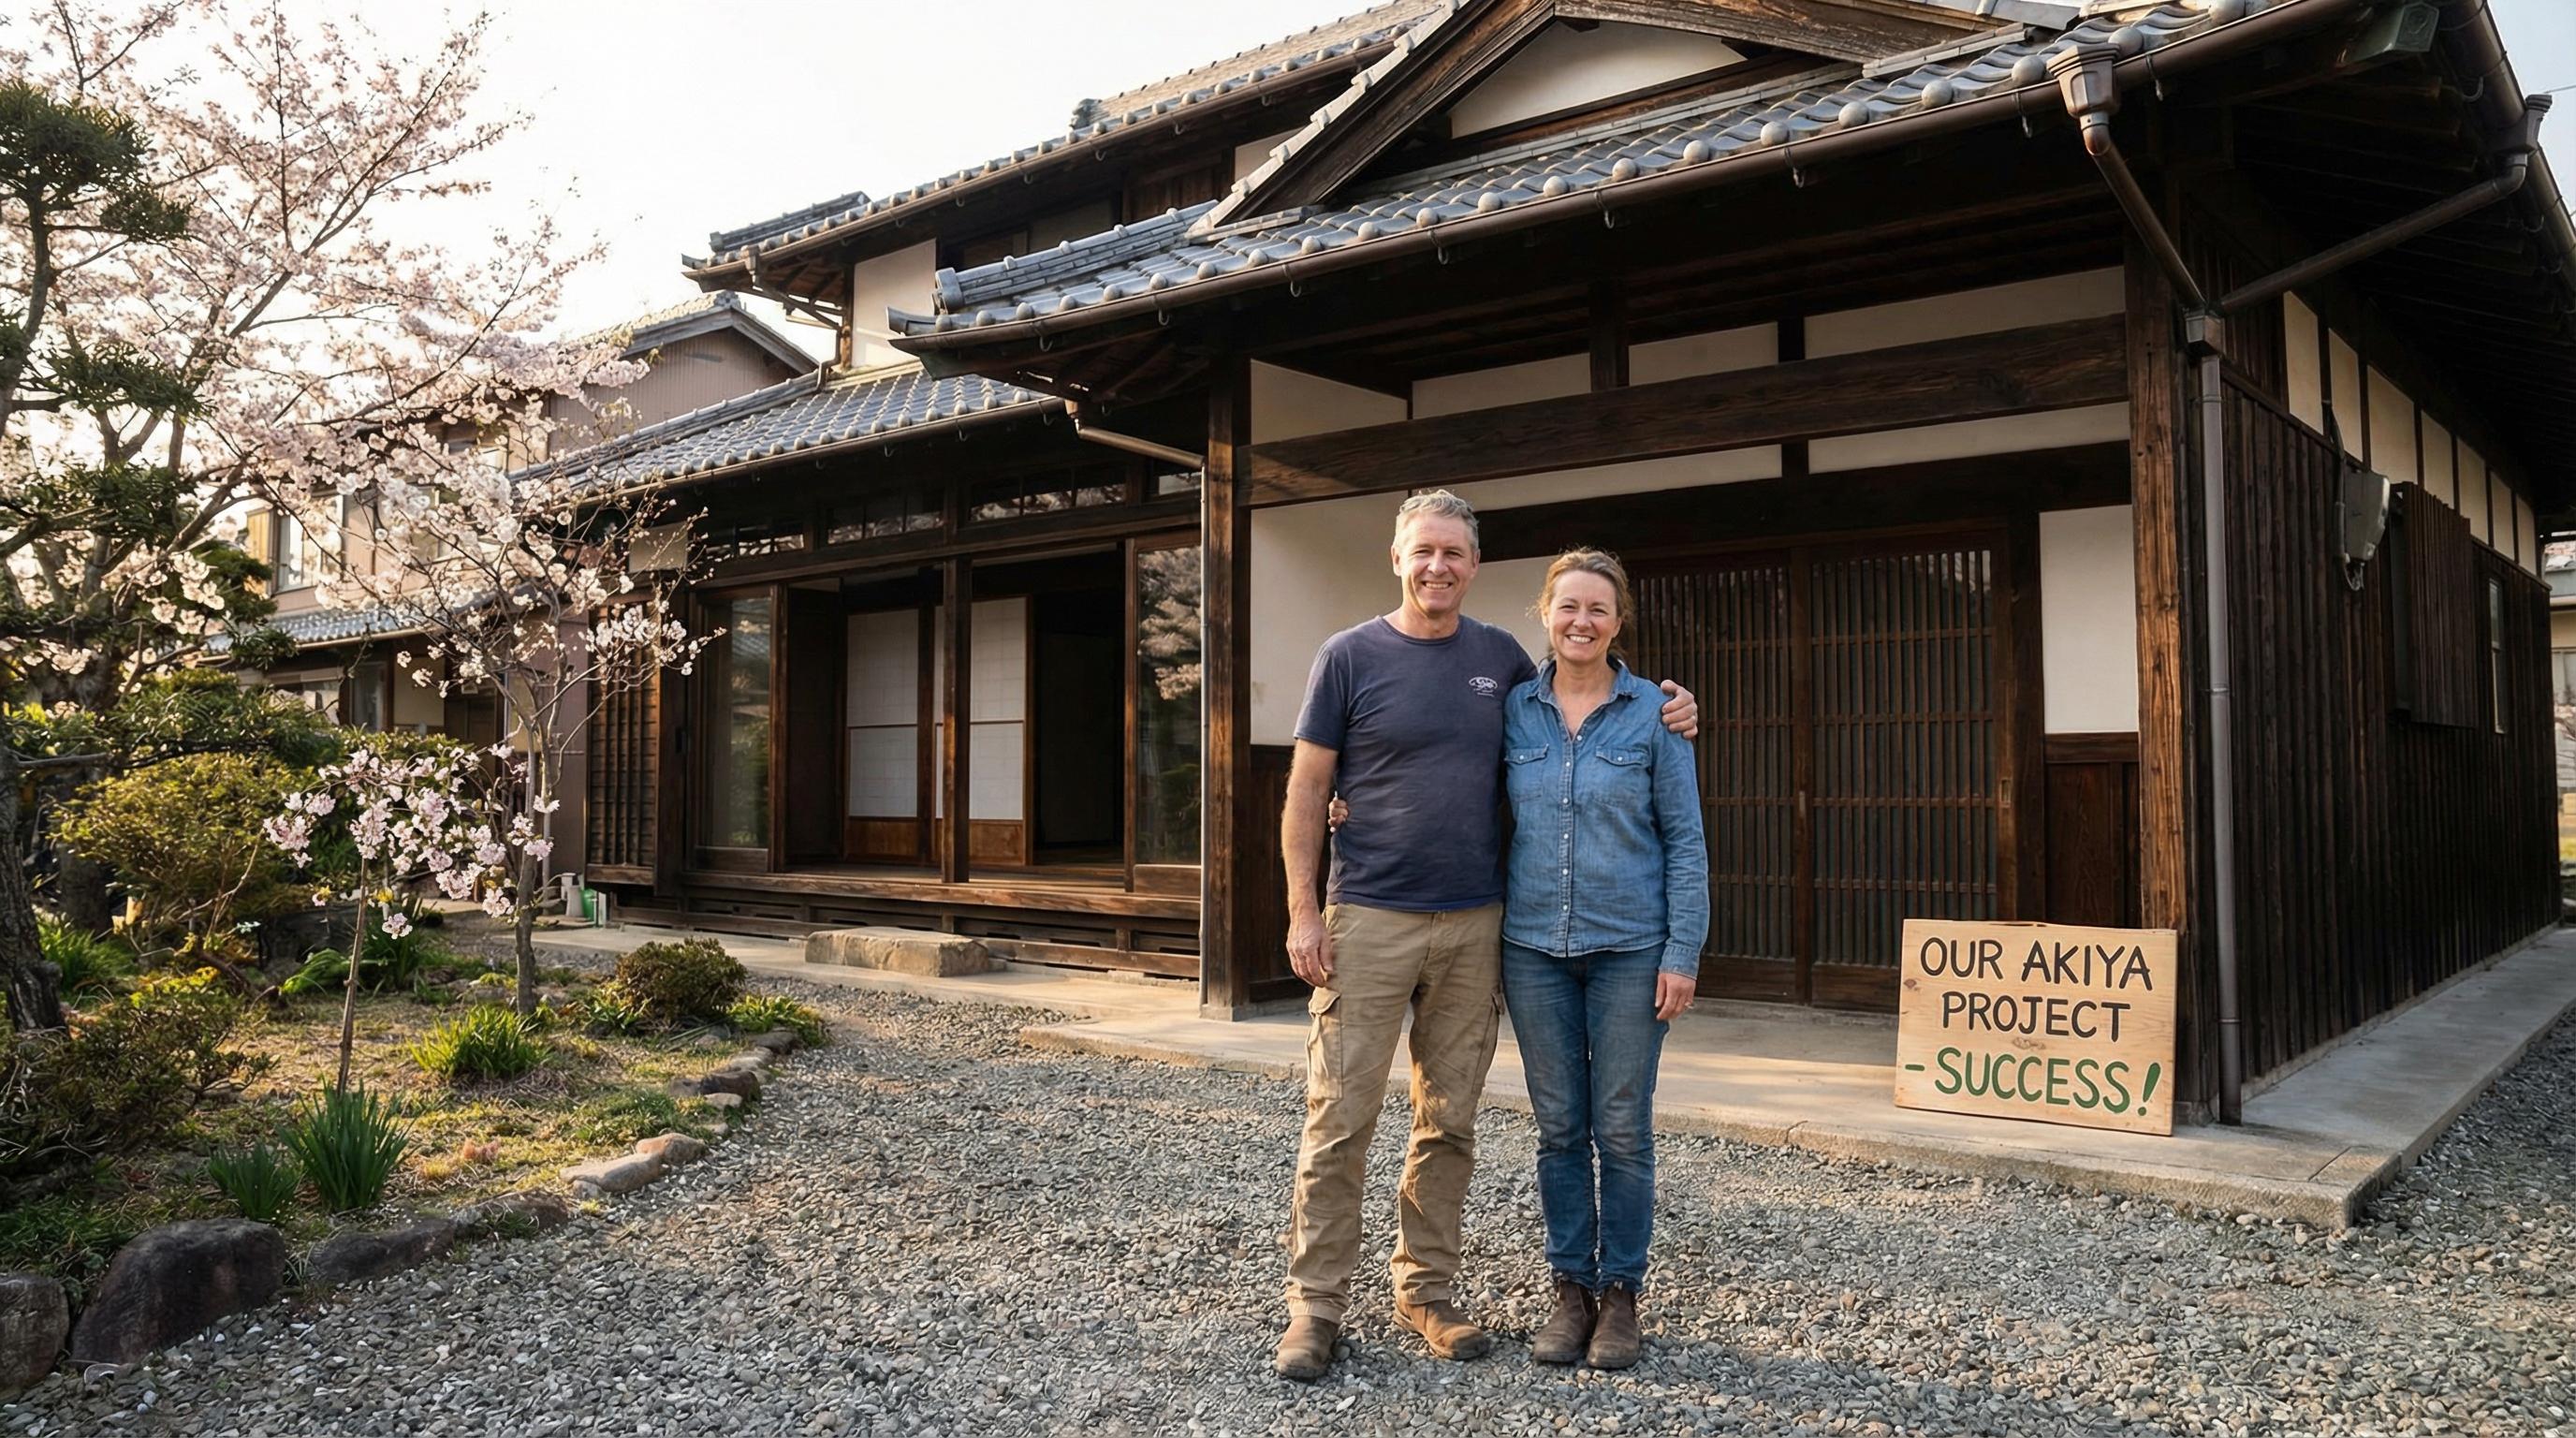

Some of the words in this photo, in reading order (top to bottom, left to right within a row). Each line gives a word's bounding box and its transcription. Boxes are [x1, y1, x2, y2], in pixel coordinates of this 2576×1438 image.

[1920, 937, 2003, 980] OUR
[2021, 940, 2153, 991] AKIYA
[1941, 990, 2131, 1043] PROJECT
